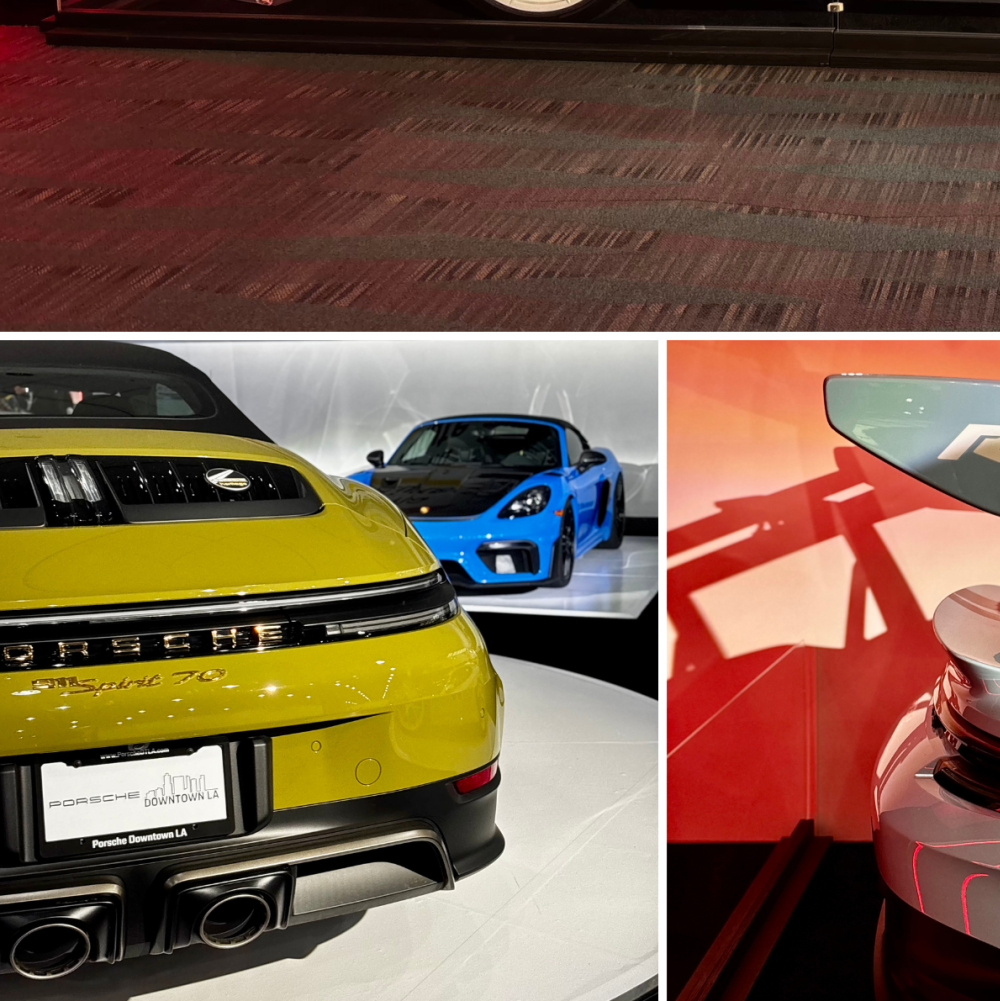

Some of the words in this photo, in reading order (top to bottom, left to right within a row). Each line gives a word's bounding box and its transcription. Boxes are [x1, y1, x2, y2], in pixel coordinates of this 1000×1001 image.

[3, 624, 283, 662] ORSCHE
[60, 673, 163, 698] Spirit
[172, 667, 227, 687] 70
[49, 791, 140, 809] PORSCHE
[144, 791, 205, 808] DOWNTOWN
[207, 790, 220, 801] LA
[92, 838, 128, 849] Porsche
[128, 831, 174, 845] Downtown
[175, 827, 188, 838] LA
